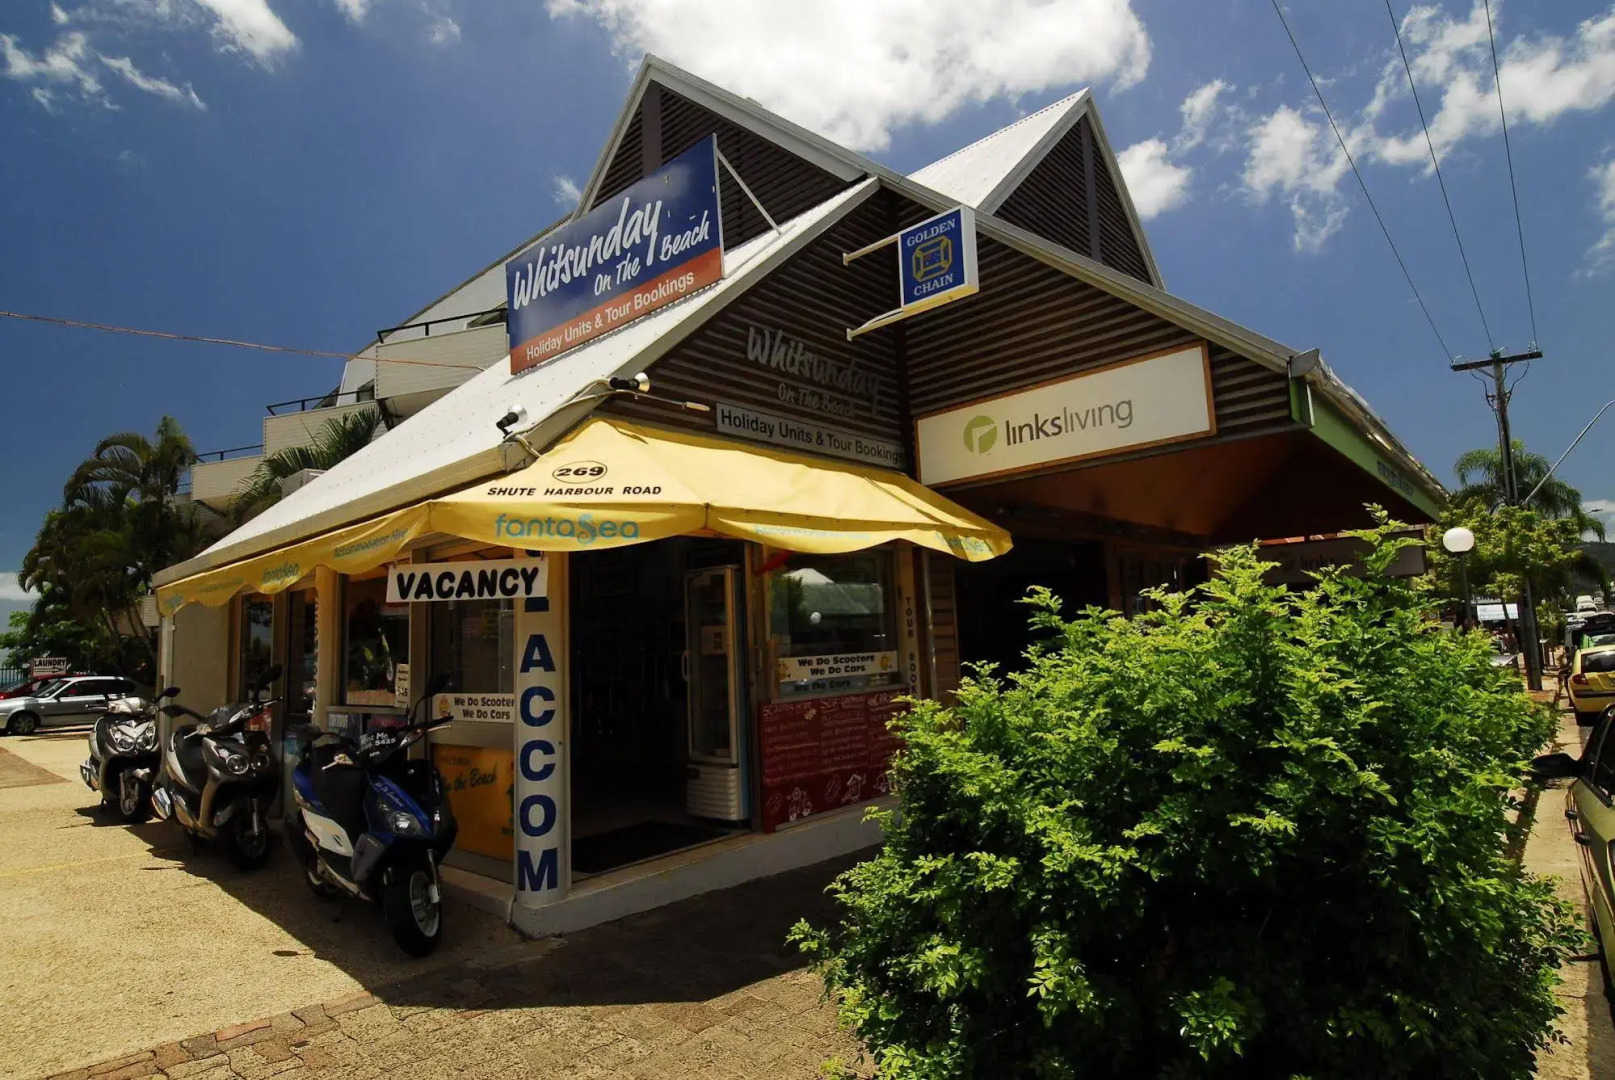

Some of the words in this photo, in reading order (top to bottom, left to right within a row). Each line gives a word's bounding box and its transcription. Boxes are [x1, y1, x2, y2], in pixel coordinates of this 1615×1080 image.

[906, 218, 956, 247] GOLDEN
[513, 197, 662, 311] Whitsunday
[594, 273, 611, 296] On
[616, 252, 641, 282] The
[660, 210, 710, 262] Beach
[913, 273, 954, 297] CHAIN
[526, 334, 563, 361] Holiday
[564, 322, 592, 341] Units
[595, 313, 603, 327] &
[605, 305, 631, 320] Tour
[634, 271, 694, 310] Bookings
[747, 326, 879, 416] Whitsunday
[721, 410, 775, 437] Holiday
[779, 422, 812, 443] Units
[816, 430, 824, 445] &
[827, 433, 853, 451] Tour
[556, 466, 604, 478] 269
[487, 486, 536, 497] SHUTE
[543, 485, 613, 497] HARBOUR
[622, 485, 663, 497] ROAD
[396, 567, 539, 599] VACANCY
[34, 659, 66, 667] LAUNDRY
[798, 658, 813, 667] We
[816, 657, 830, 666] Do
[833, 654, 875, 665] Scooters
[810, 667, 825, 676] We
[828, 666, 841, 675] Do
[844, 664, 866, 673] Cars
[454, 698, 466, 706] We
[468, 698, 479, 706] Do
[463, 709, 475, 718] We
[476, 710, 488, 718] Do
[490, 710, 510, 719] Cars
[518, 634, 559, 892] ACCOM
